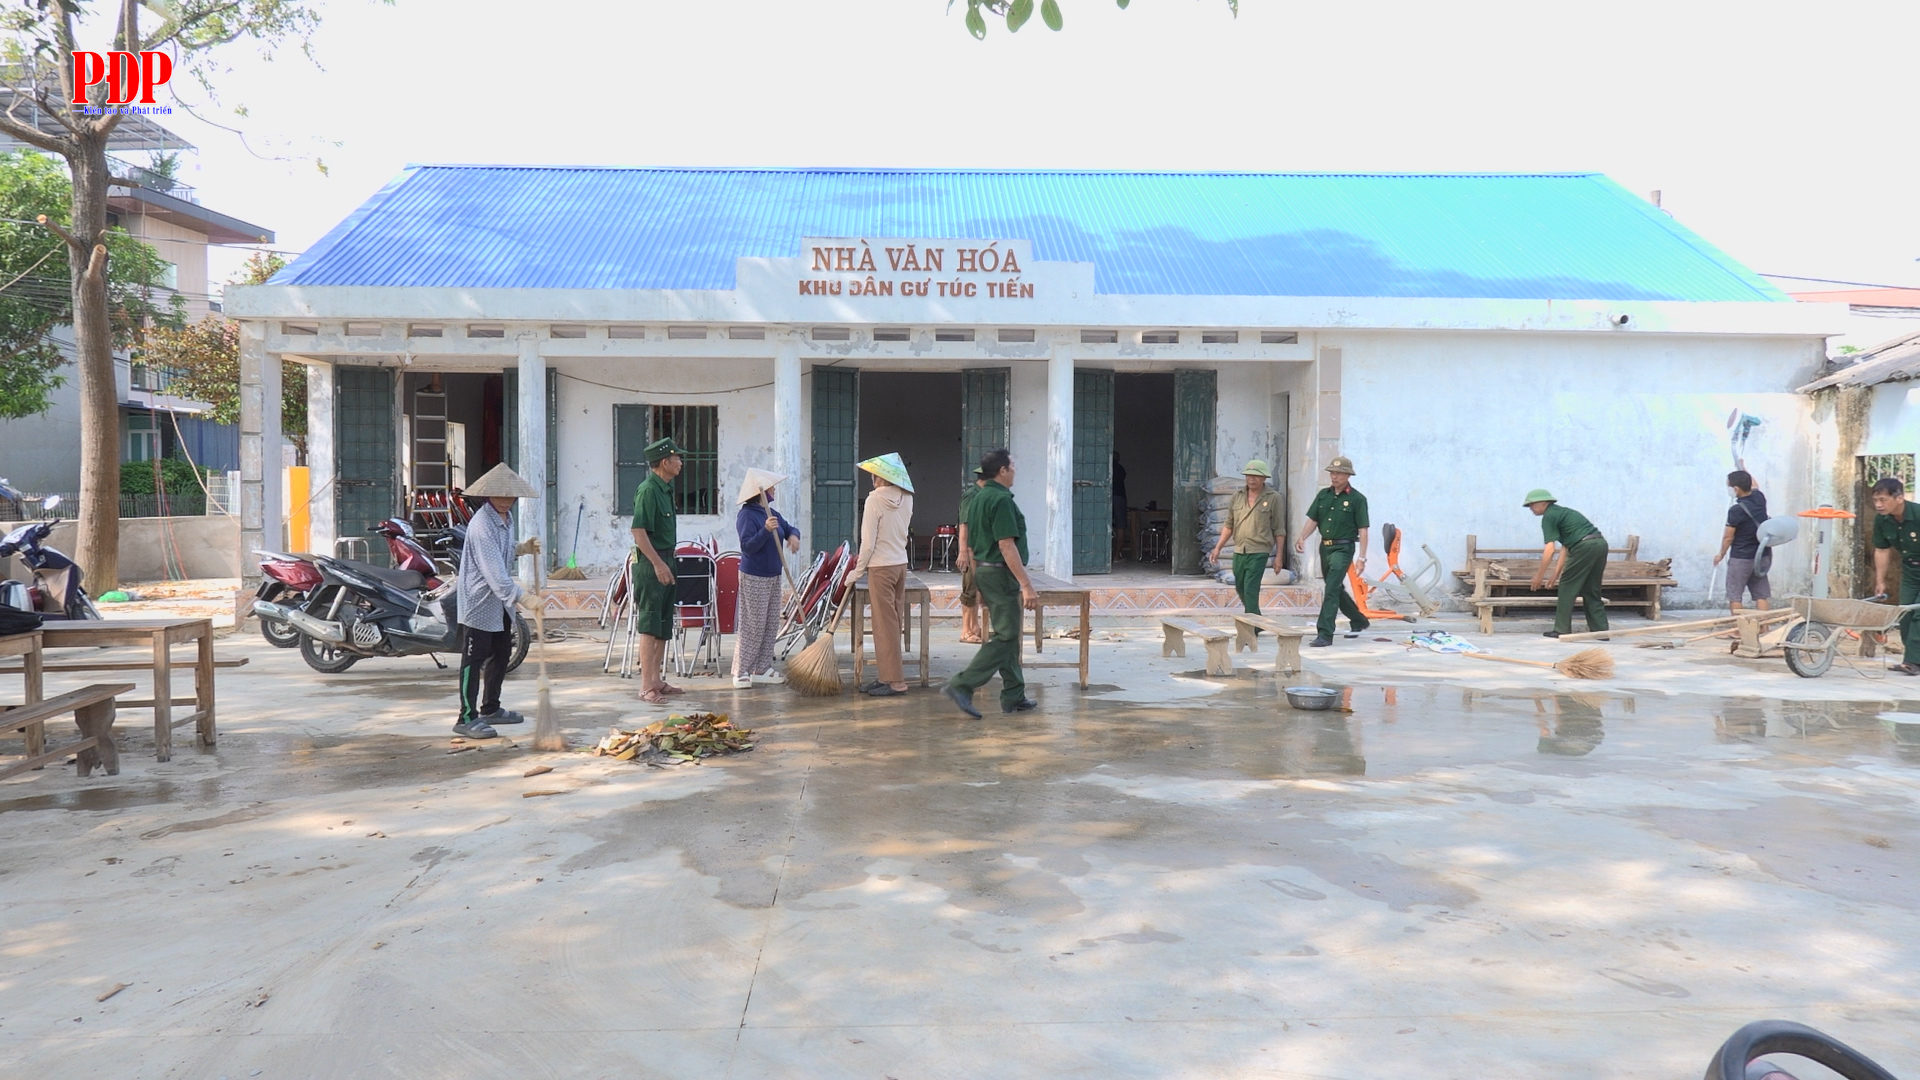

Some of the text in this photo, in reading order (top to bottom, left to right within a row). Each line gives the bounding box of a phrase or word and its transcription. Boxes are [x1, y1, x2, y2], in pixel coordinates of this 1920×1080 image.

[812, 239, 1021, 272] NHÀ VĂN HÓA
[799, 280, 842, 295] KHU
[901, 278, 931, 296] CƯ
[937, 277, 977, 297] TÚC
[987, 276, 1034, 298] TIẾN
